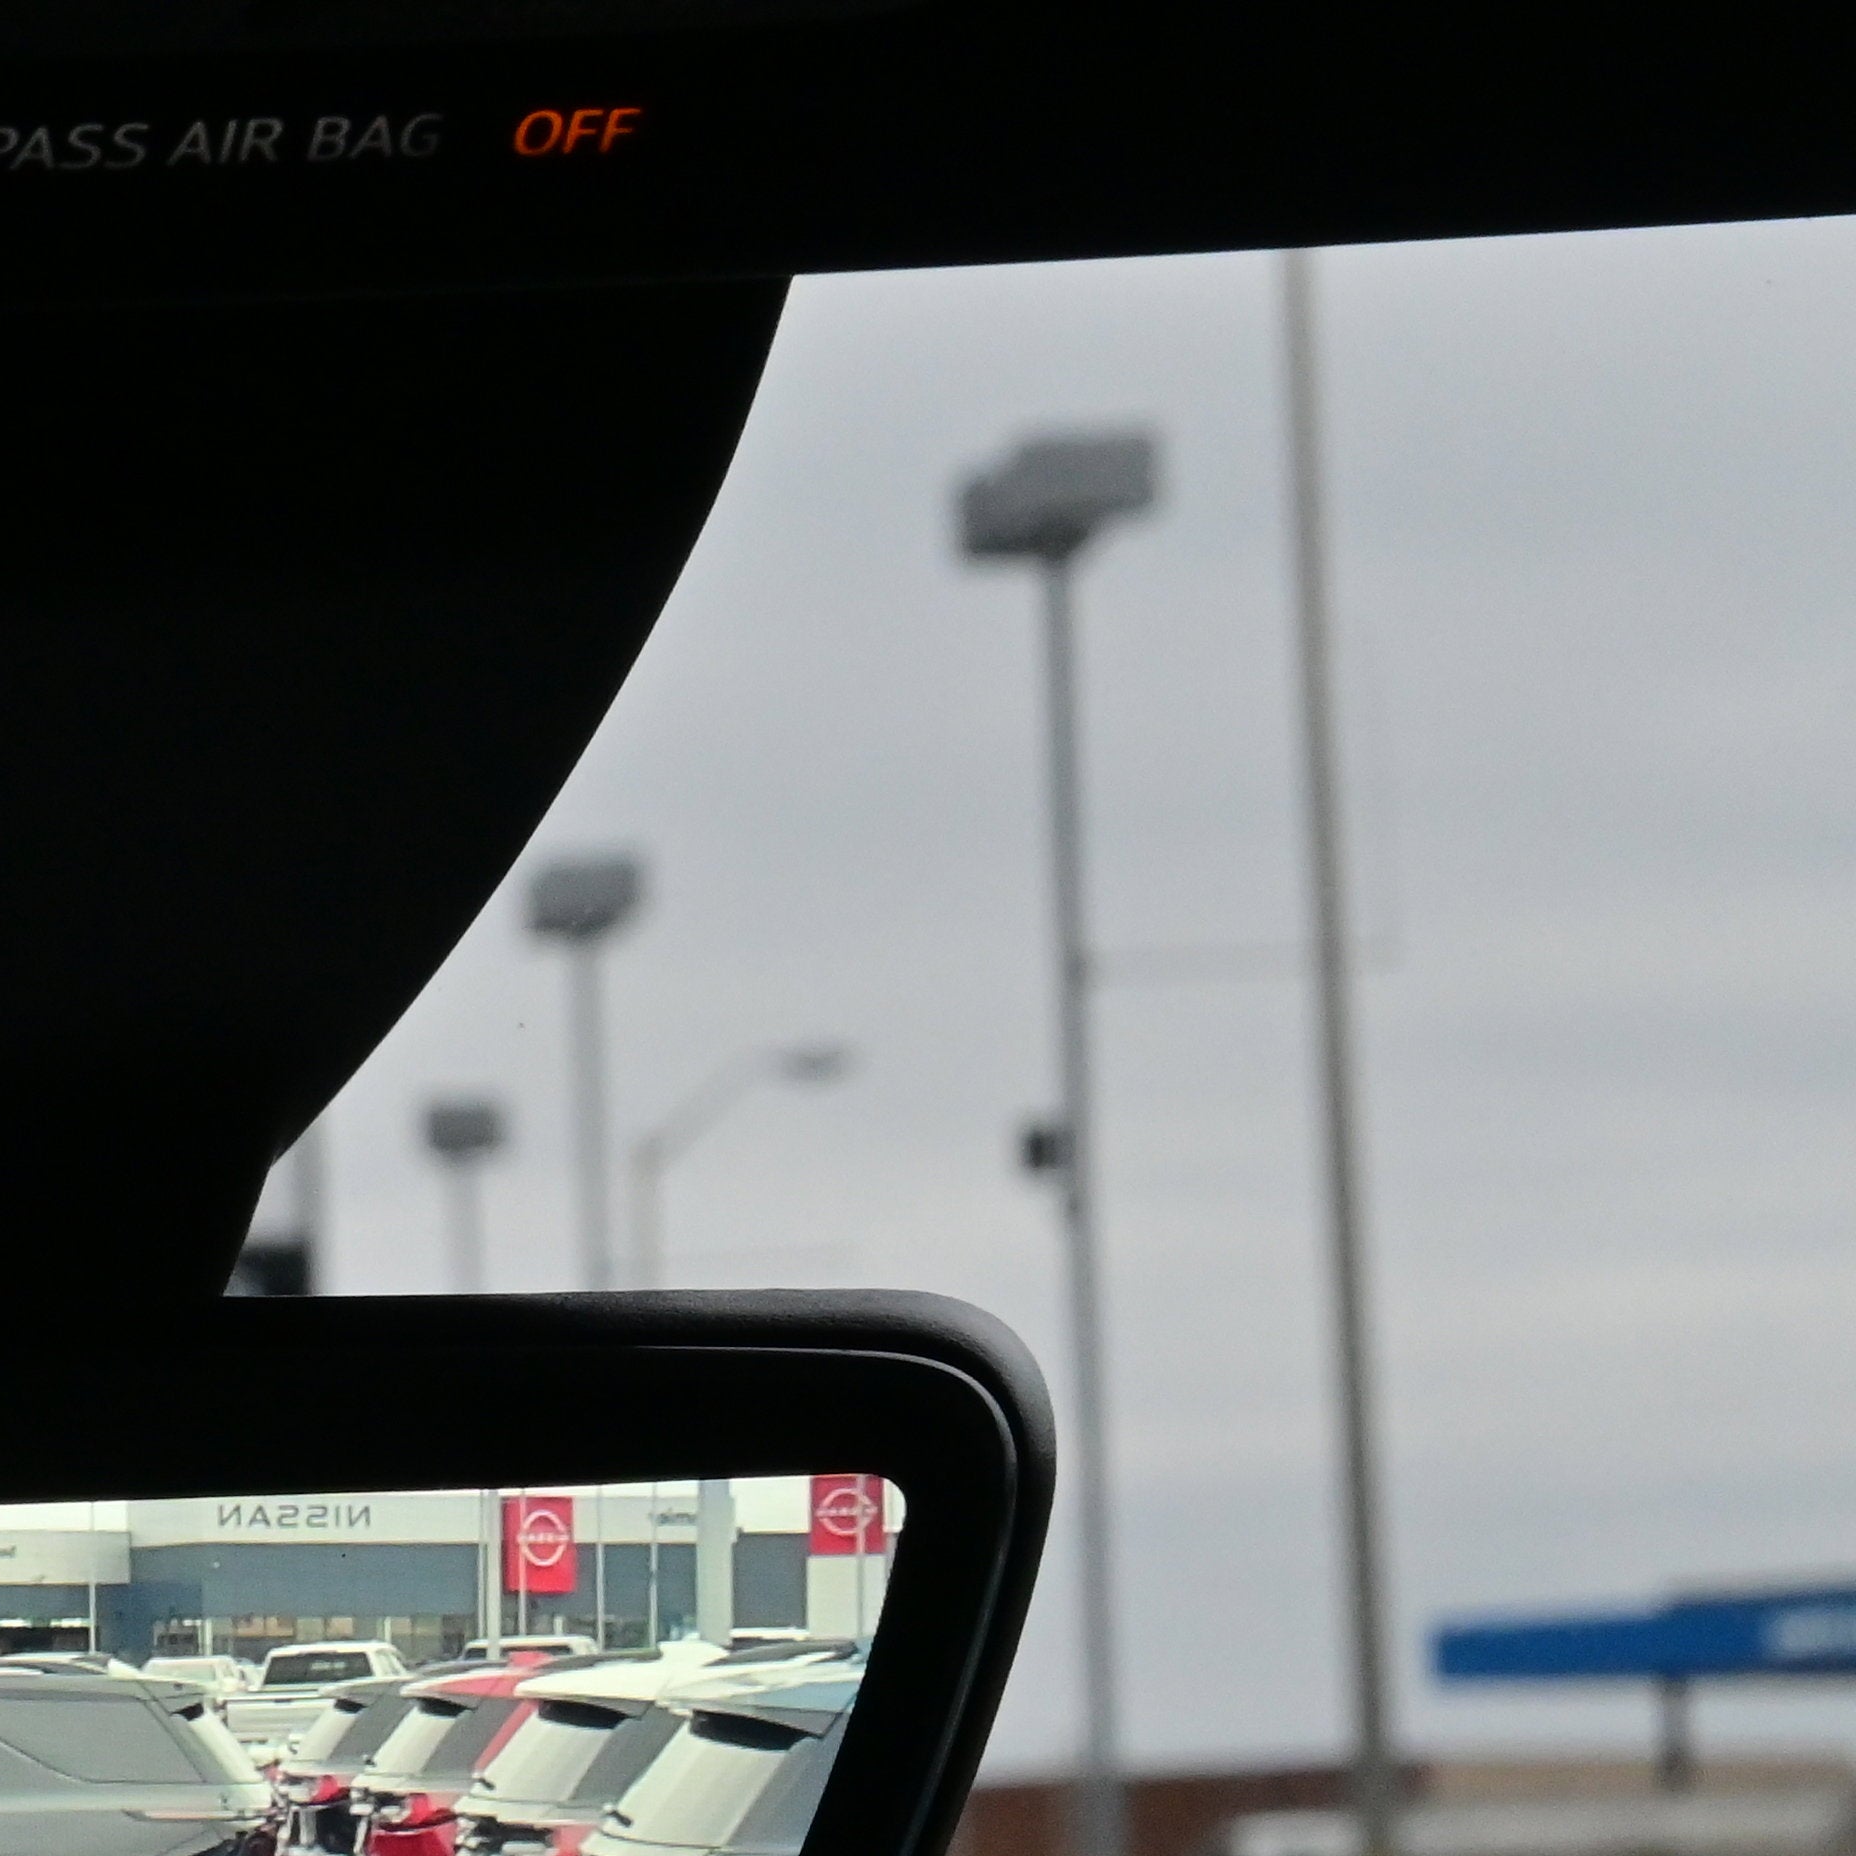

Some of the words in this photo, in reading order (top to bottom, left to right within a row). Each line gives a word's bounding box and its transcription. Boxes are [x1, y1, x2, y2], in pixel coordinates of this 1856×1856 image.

[168, 117, 284, 163] AIR
[307, 112, 444, 160] BAG
[513, 107, 641, 154] OFF
